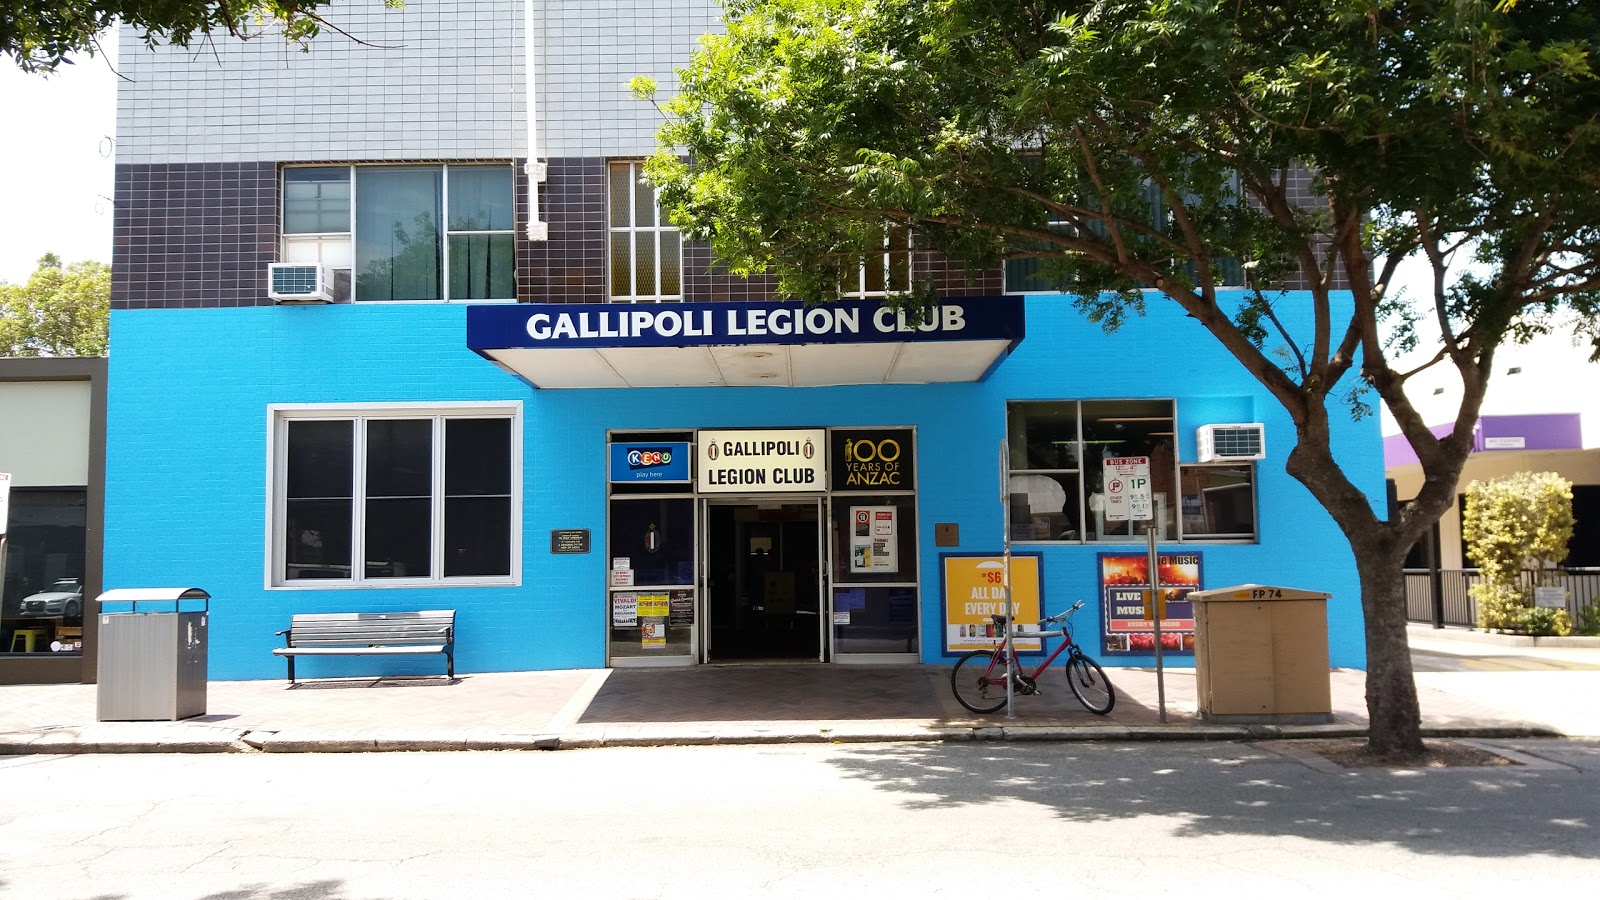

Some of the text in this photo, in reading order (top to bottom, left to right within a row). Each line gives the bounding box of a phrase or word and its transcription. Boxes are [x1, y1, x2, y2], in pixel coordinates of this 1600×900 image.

[526, 305, 966, 339] GALLIPOLI LEGION CLUB
[723, 441, 800, 457] GALLIPOLI
[845, 438, 900, 462] 100
[629, 452, 670, 464] KENO
[846, 462, 899, 471] YEARS OF
[708, 468, 815, 485] LEGION CLUB
[846, 472, 900, 485] ANZAC
[1131, 478, 1146, 489] 1P
[971, 586, 1012, 599] ALL DA
[1116, 592, 1141, 601] LIVE
[1252, 590, 1266, 599] FP
[1268, 589, 1282, 598] 74
[965, 602, 996, 615] EVERY
